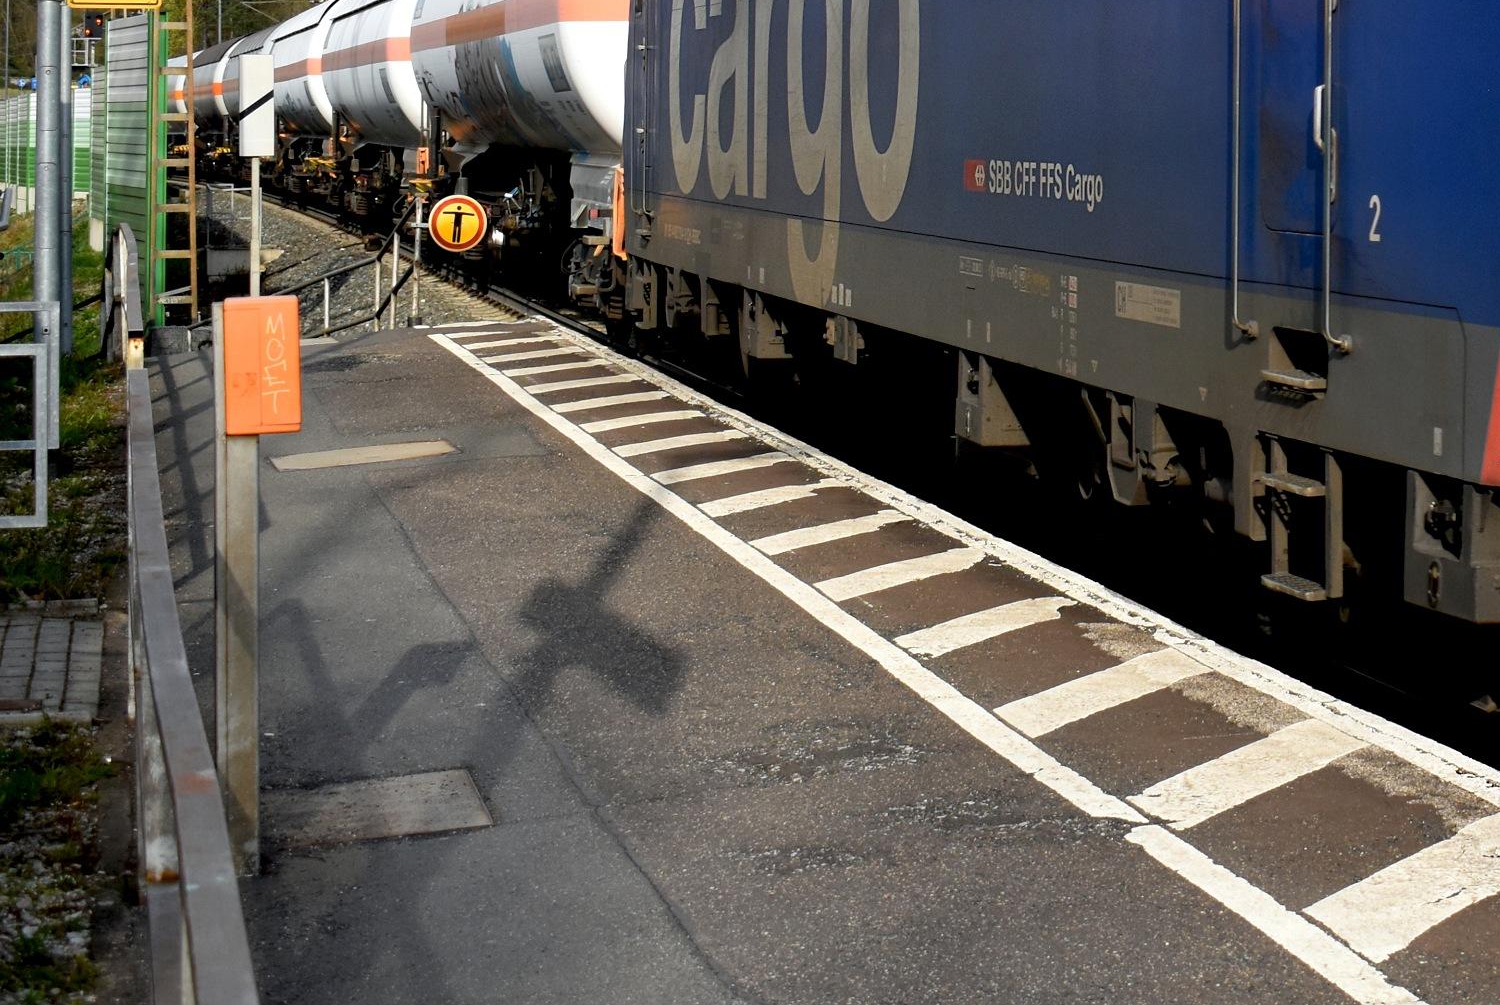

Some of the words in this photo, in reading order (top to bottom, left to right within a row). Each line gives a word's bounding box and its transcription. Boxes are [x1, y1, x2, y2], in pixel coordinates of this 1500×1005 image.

[988, 159, 1012, 195] SBB
[1014, 161, 1037, 197] CFF
[1039, 162, 1063, 200] FFS
[1065, 163, 1104, 213] Cargo
[1369, 194, 1381, 242] 2
